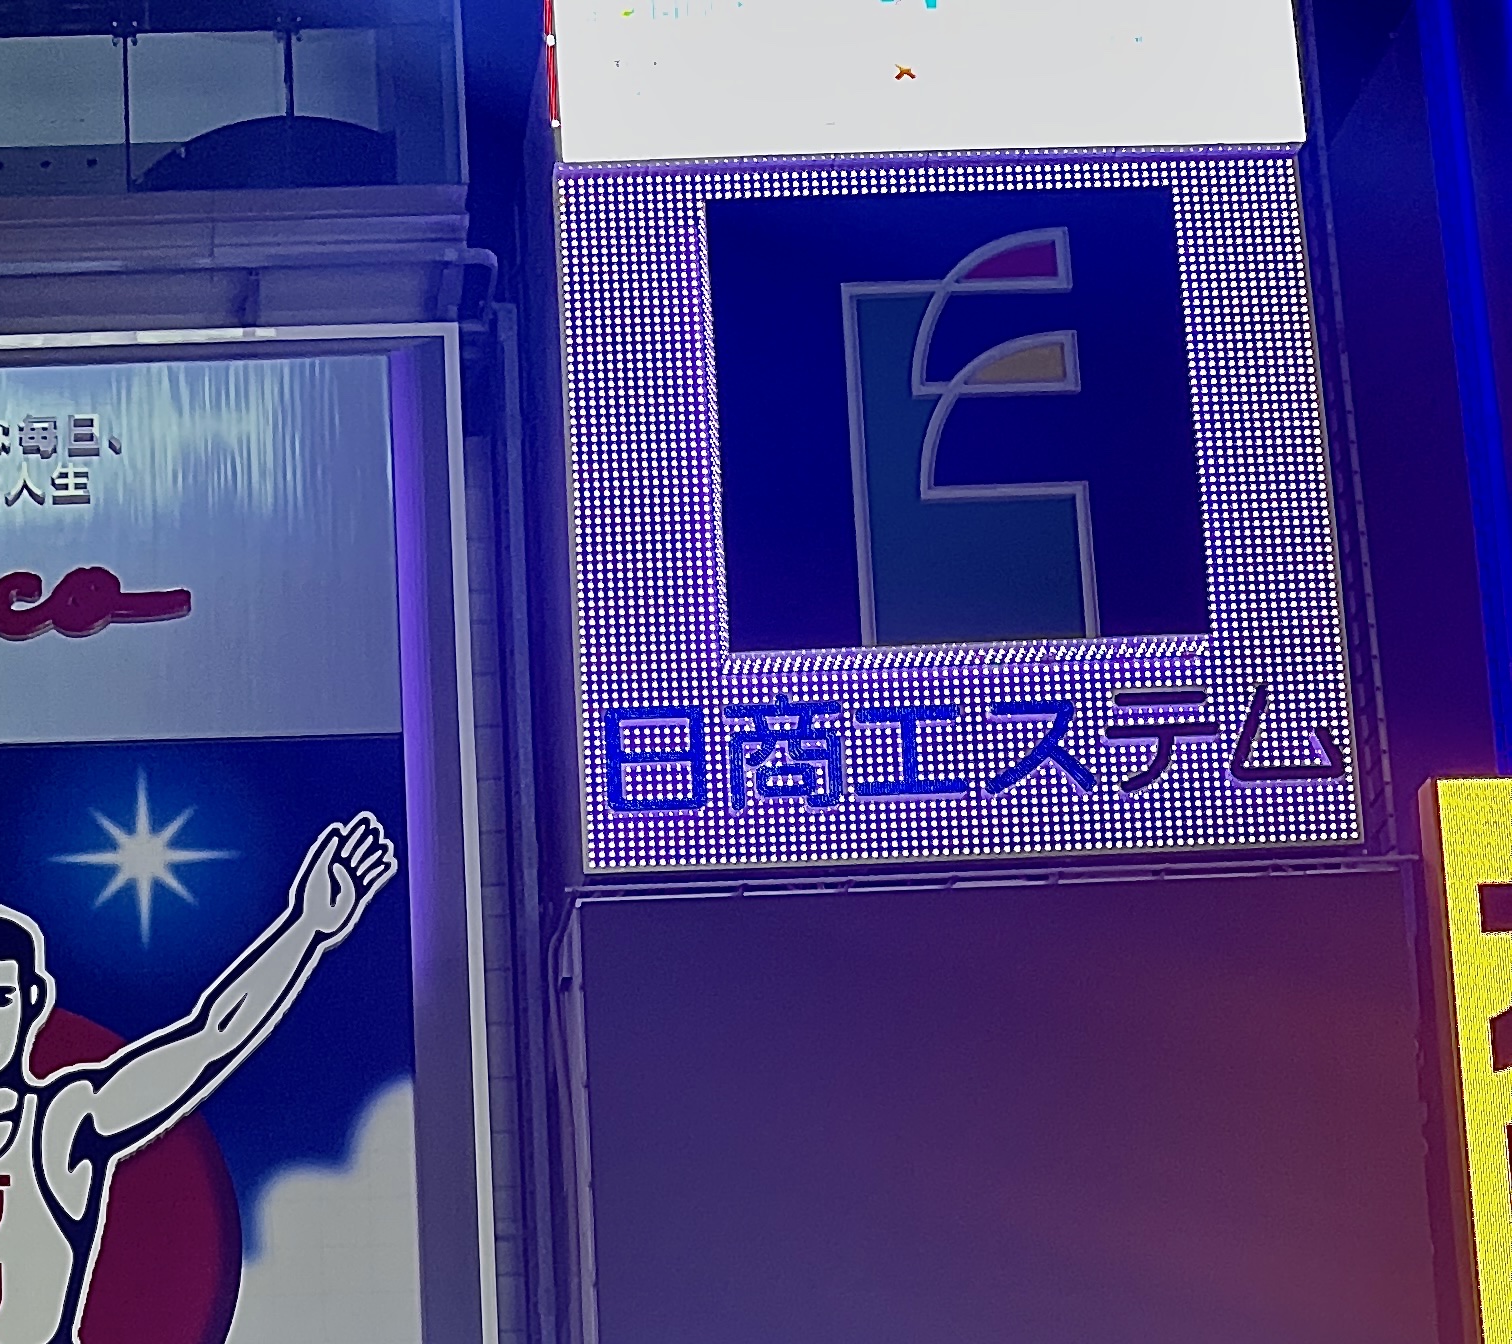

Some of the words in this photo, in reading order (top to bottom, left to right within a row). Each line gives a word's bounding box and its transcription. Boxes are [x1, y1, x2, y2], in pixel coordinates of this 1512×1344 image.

[604, 680, 1346, 819] 日商エステム
